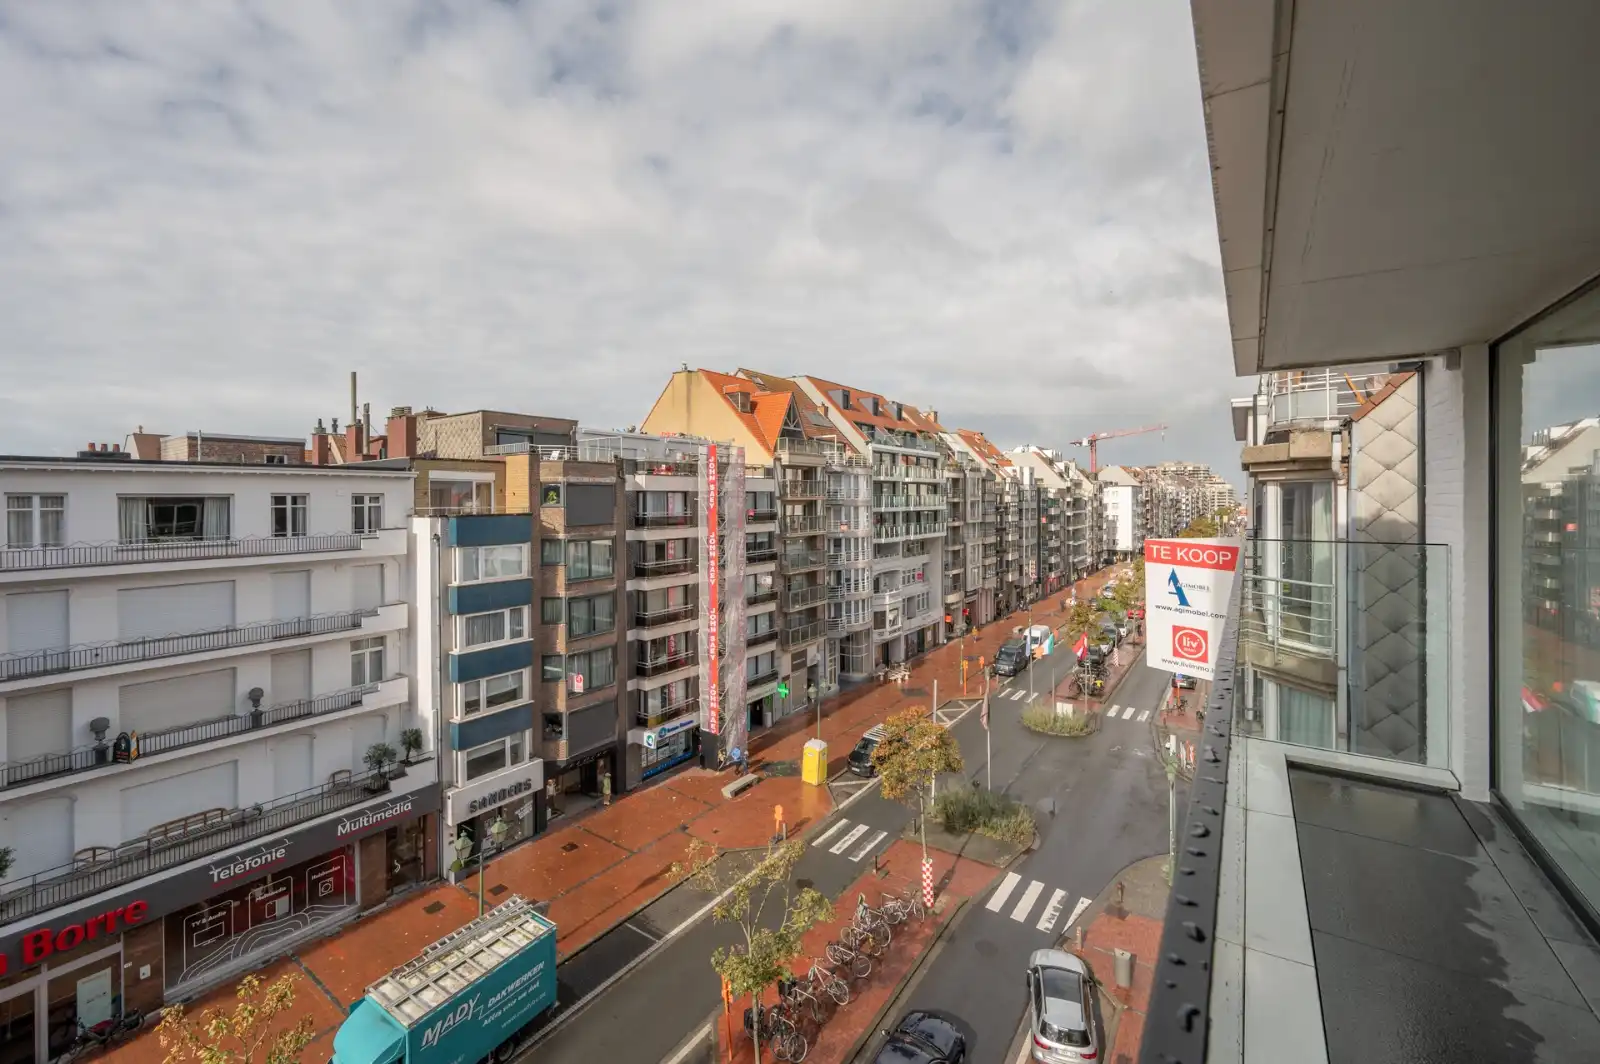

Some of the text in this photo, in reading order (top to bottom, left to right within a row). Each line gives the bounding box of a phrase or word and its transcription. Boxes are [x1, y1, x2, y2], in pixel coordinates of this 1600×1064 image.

[1149, 544, 1232, 565] TE KOOP
[1155, 604, 1227, 619] www.agimobel.com
[709, 608, 717, 660] JOHN SAEY
[468, 778, 533, 814] SANDERS
[337, 801, 412, 836] Multimedia
[209, 847, 287, 883] Telefonie
[22, 899, 149, 965] Borre
[421, 992, 481, 1047] MADY
[487, 961, 545, 1008] DAKWERKEN
